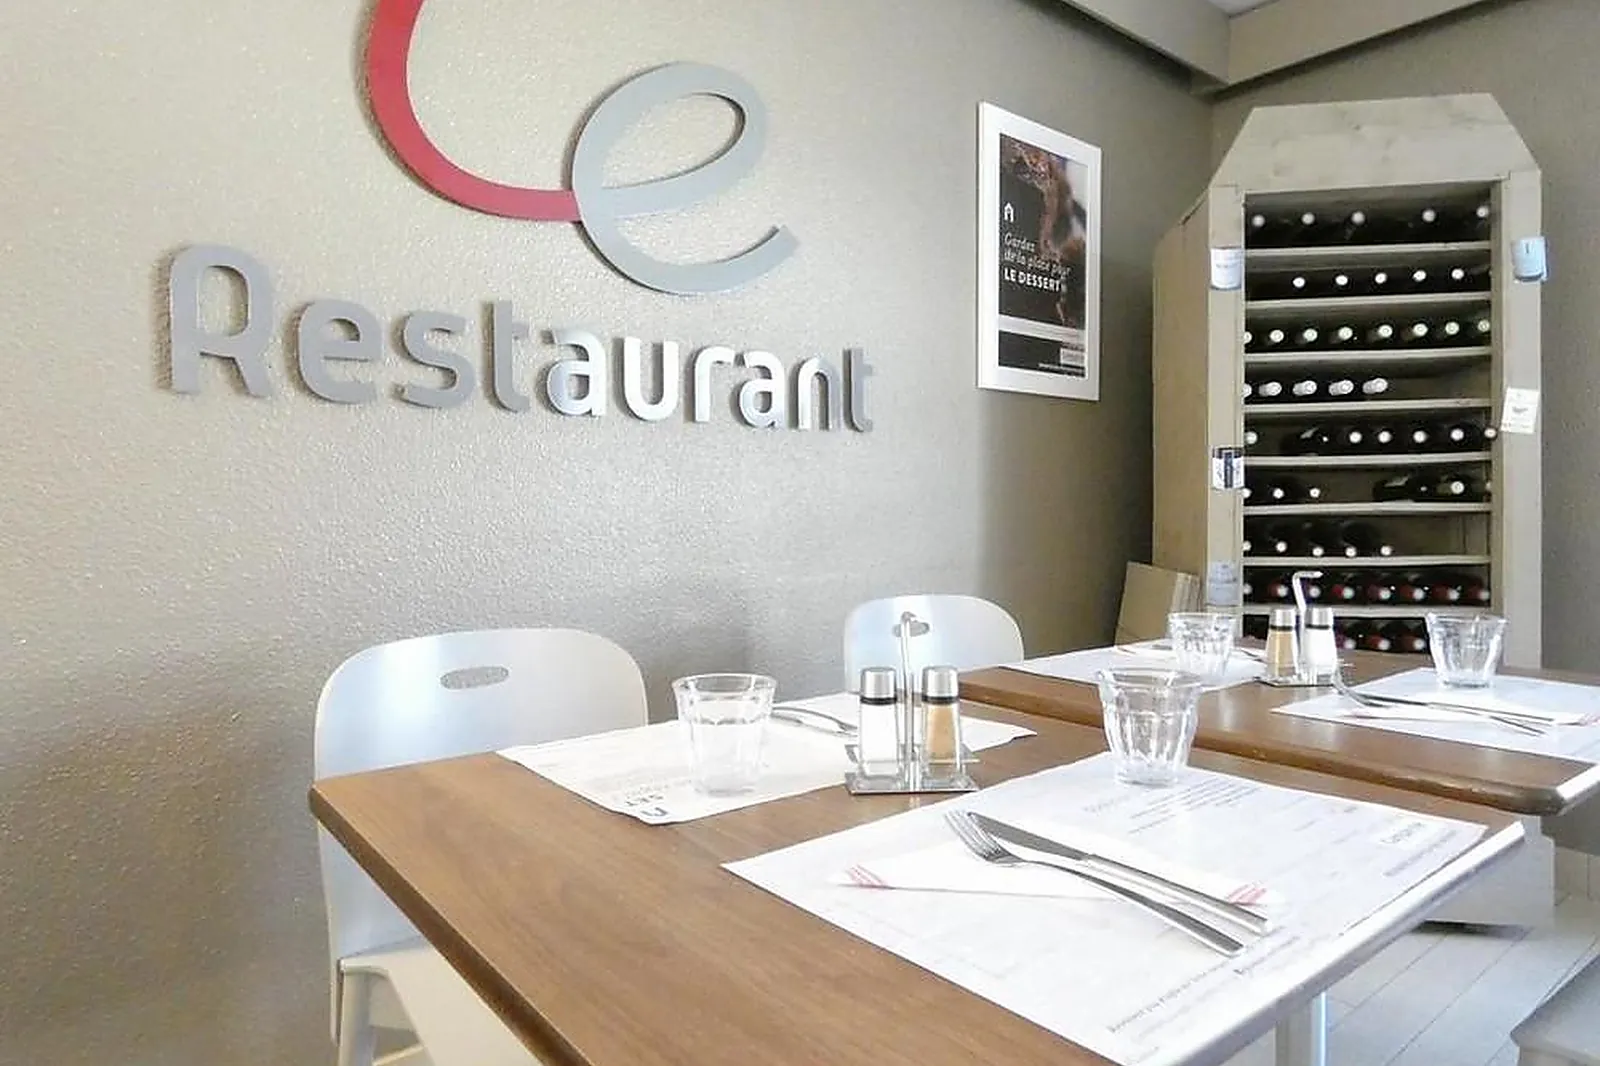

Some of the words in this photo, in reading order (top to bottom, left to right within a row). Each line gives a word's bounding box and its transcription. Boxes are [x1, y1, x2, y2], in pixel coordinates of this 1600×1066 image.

[1004, 267, 1017, 282] LE
[1018, 271, 1061, 292] DESSERT
[168, 243, 875, 433] Restaurant
